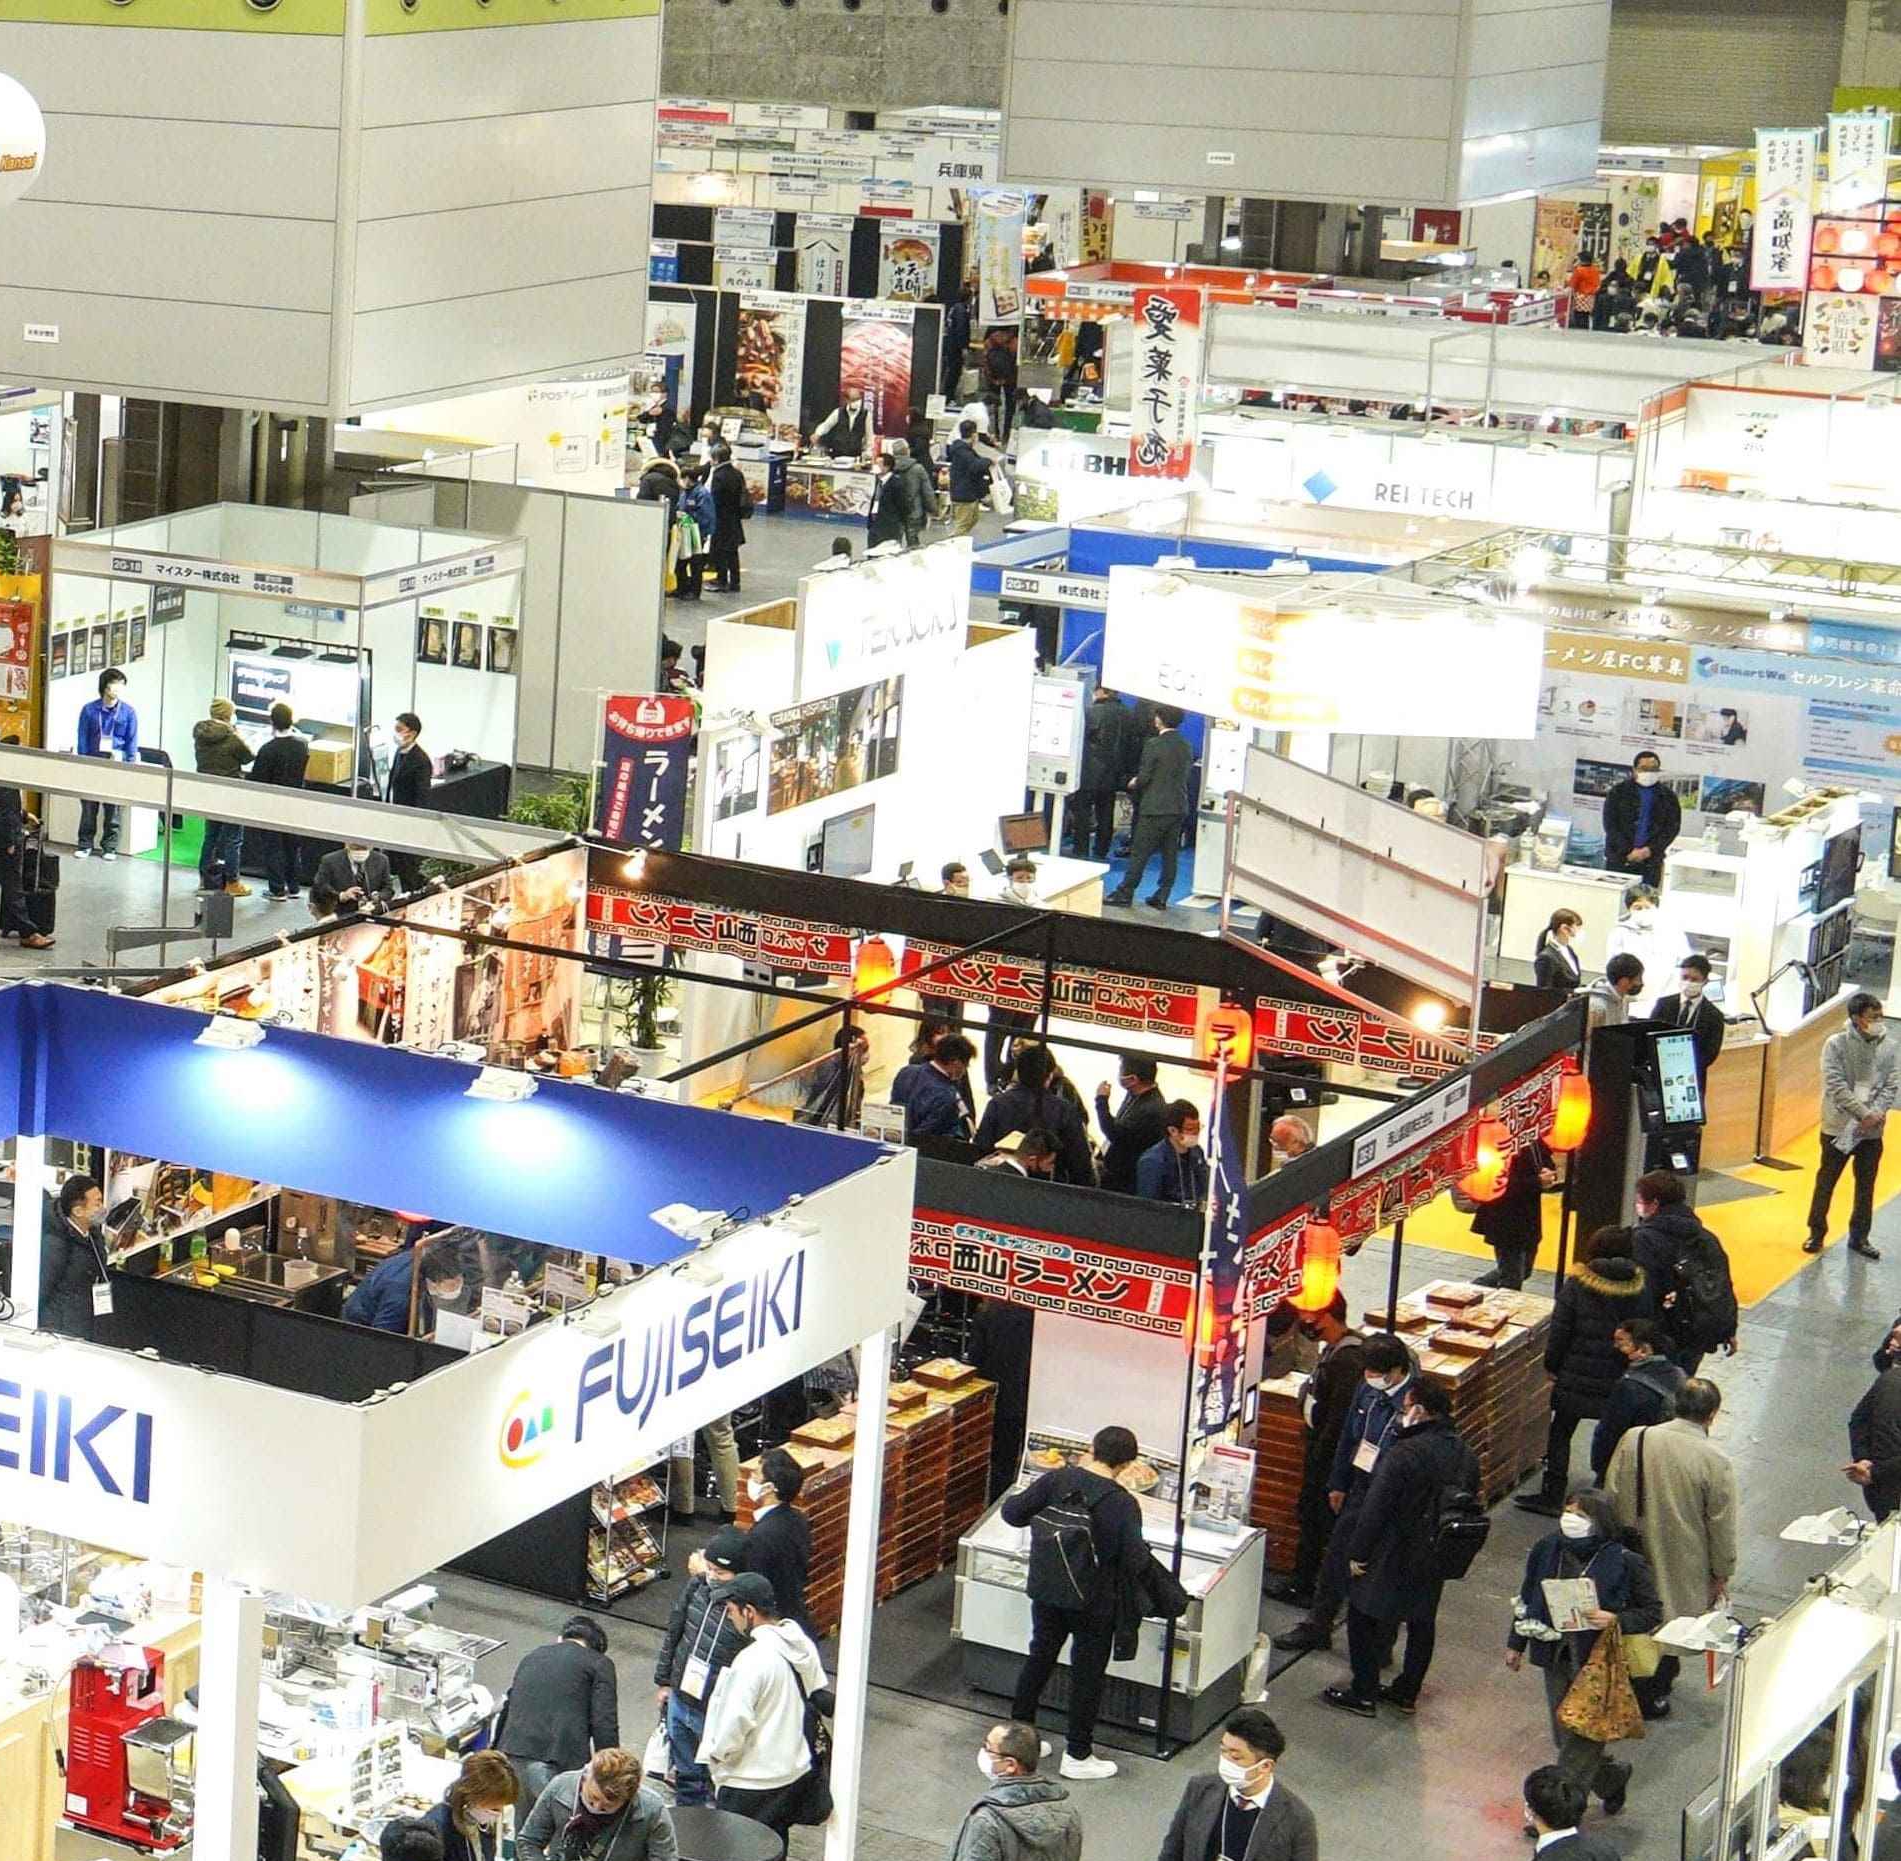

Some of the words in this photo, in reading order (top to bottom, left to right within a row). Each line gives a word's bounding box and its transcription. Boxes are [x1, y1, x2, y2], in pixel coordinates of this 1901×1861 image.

[938, 162, 983, 180] 兵庫県
[1375, 482, 1409, 503] REI
[1416, 487, 1473, 510] TECH
[155, 564, 241, 584] マイスター株式会社
[1058, 584, 1100, 600] 株式会社
[641, 750, 670, 848] ラーメン
[953, 1240, 1130, 1300] 西山ラーメン
[575, 1250, 805, 1442] FUJISEIKI
